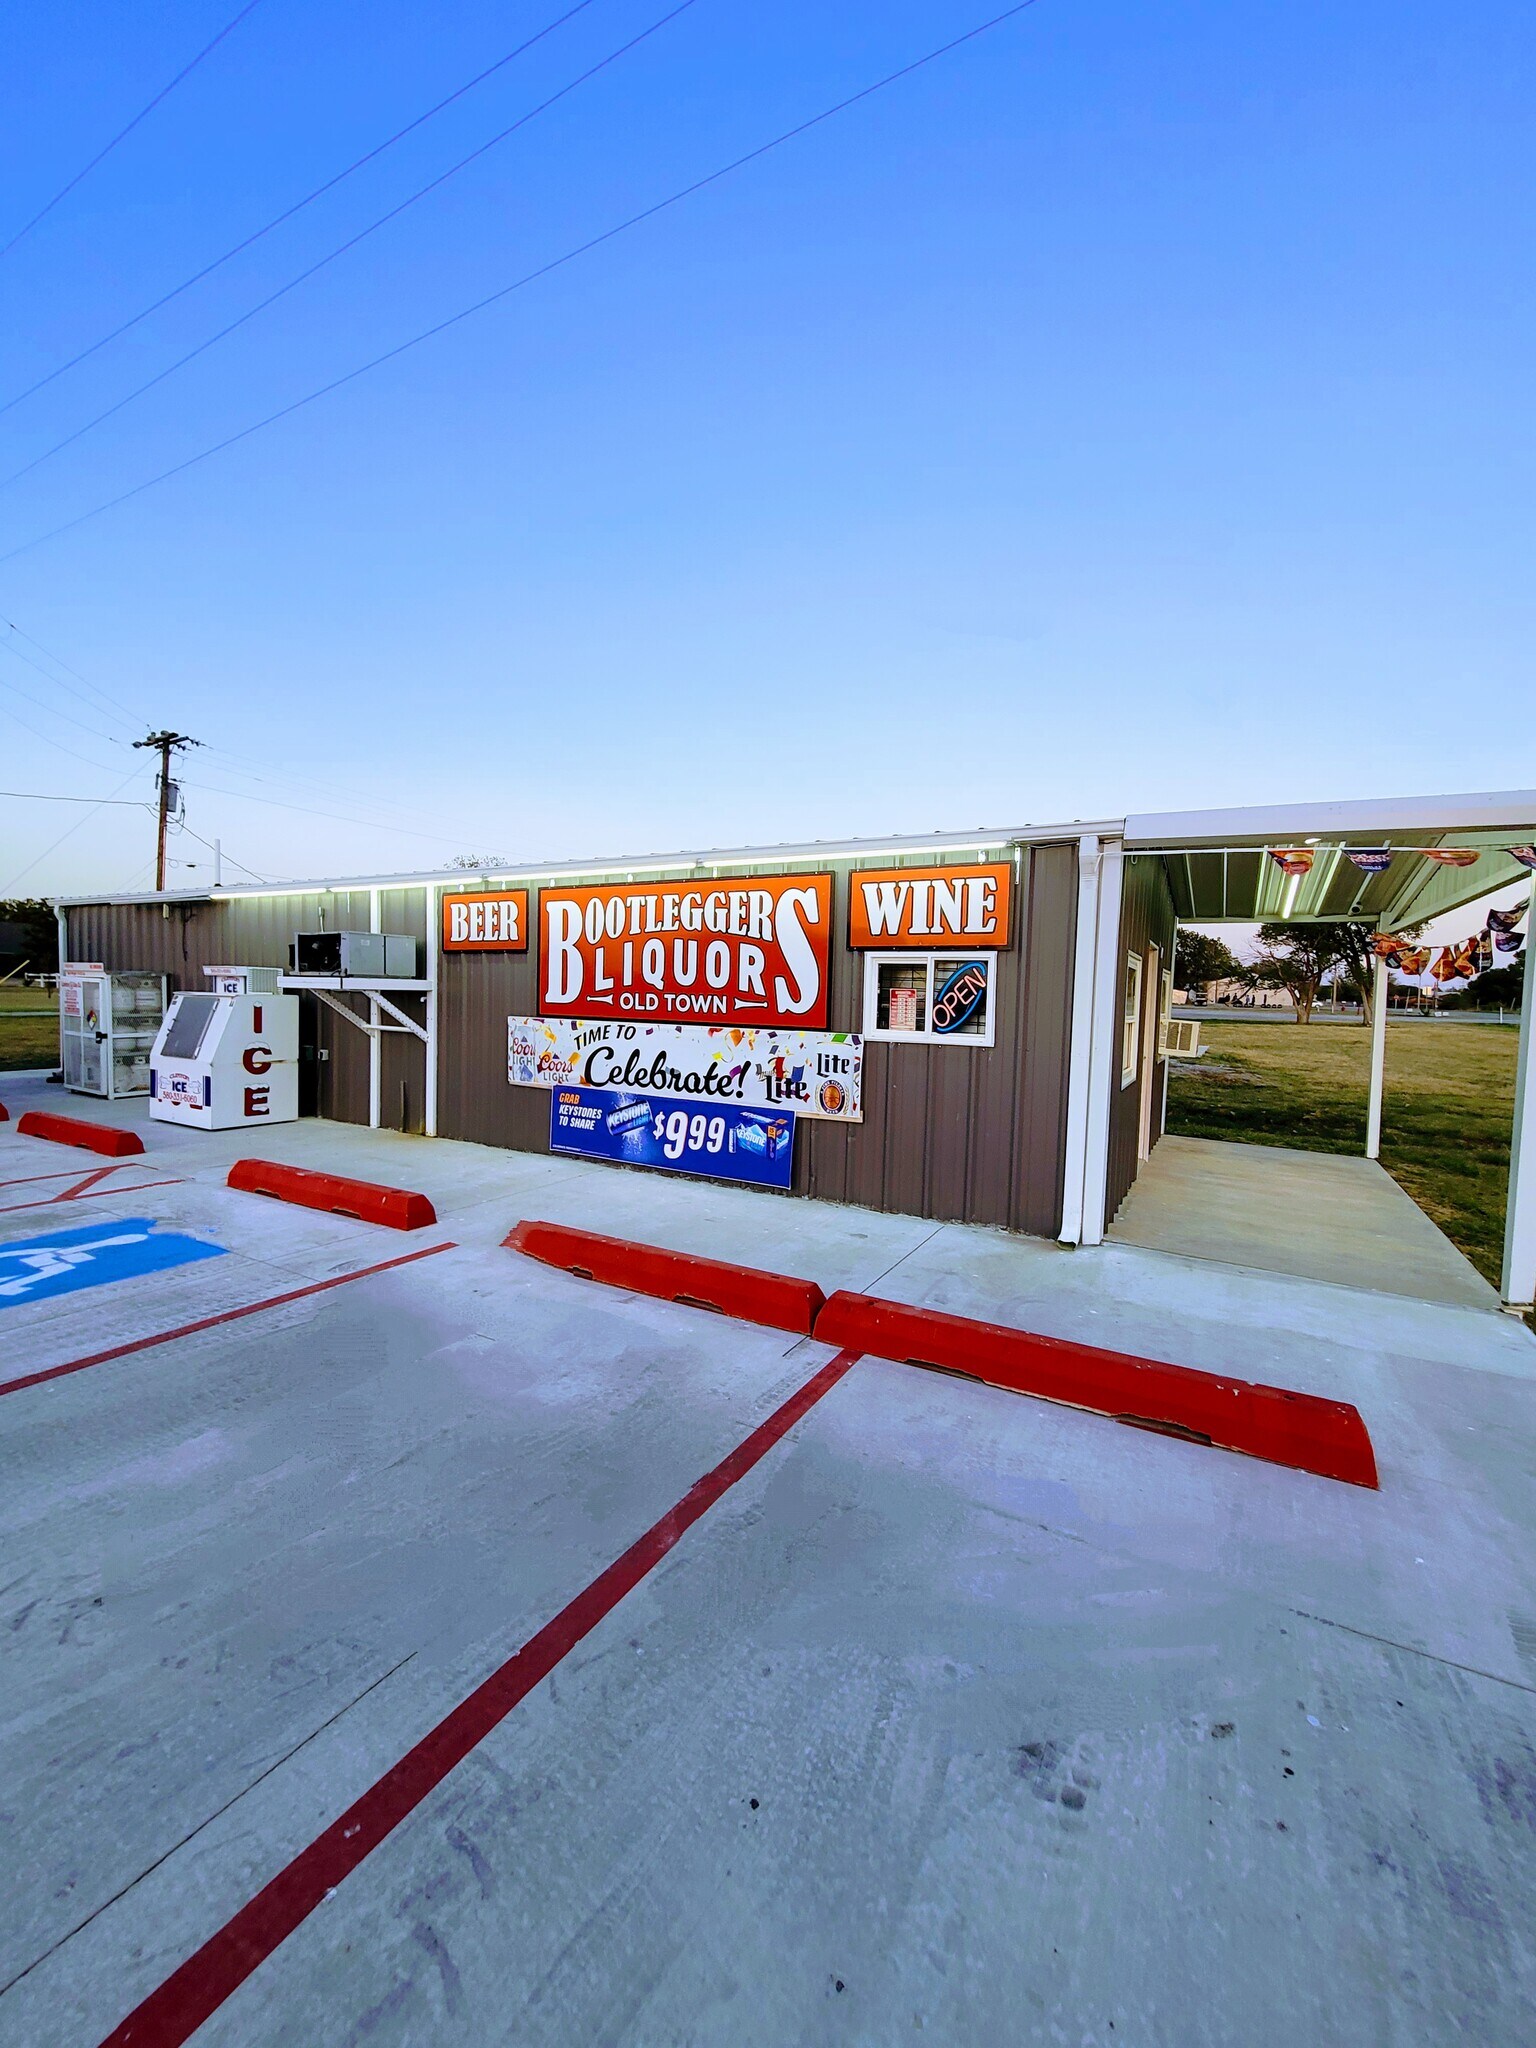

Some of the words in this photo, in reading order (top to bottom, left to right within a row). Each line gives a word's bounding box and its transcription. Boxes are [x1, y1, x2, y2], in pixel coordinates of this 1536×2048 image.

[861, 876, 998, 936] WINE
[449, 900, 519, 943] BEER
[544, 886, 821, 1015] BOOTLEGGERS
[594, 938, 766, 996] LIQUOR
[224, 983, 238, 993] ICE
[933, 967, 987, 1028] OPEN
[619, 993, 662, 1011] OLD
[664, 993, 727, 1014] TOWN
[573, 1024, 610, 1051] TIME
[615, 1024, 637, 1041] TO
[537, 1054, 574, 1074] Coors
[583, 1045, 752, 1099] Celebrate!
[816, 1053, 850, 1078] Lite
[172, 1081, 187, 1093] ICE
[543, 1071, 569, 1084] LIGHT
[757, 1075, 807, 1105] Lite
[559, 1092, 580, 1105] GRAB
[558, 1115, 569, 1127] TO
[569, 1117, 596, 1131] SHARE
[559, 1104, 603, 1120] KEYSTONES
[608, 1102, 650, 1128] KEYSTONE
